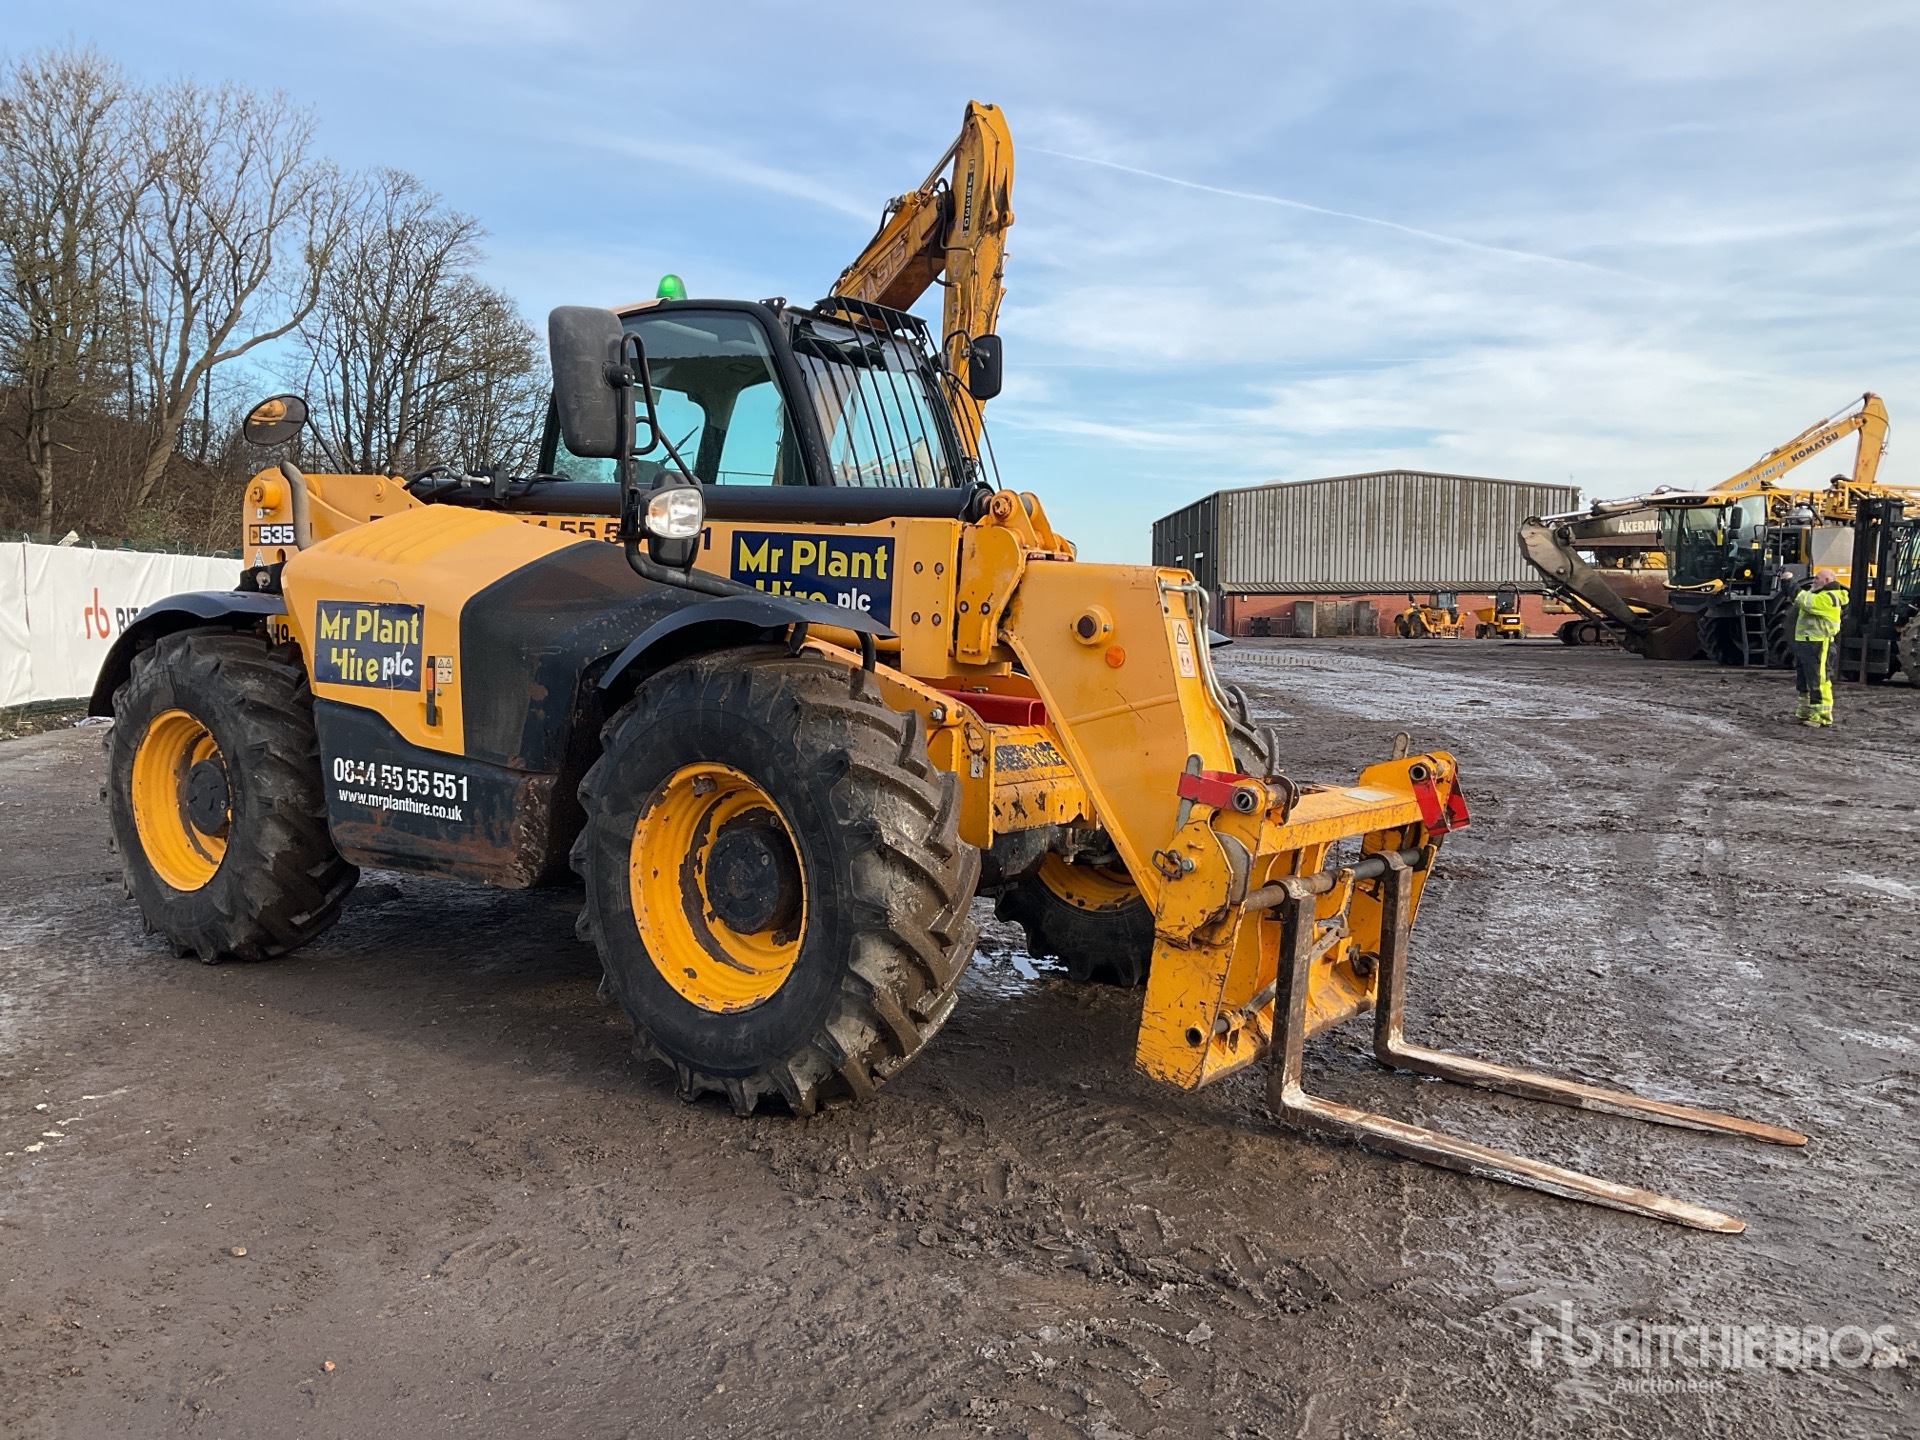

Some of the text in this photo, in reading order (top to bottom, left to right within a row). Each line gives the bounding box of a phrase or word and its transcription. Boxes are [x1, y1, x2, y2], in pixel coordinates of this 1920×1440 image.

[1790, 431, 1839, 462] KOMATSU
[738, 536, 888, 580] Mr Plant
[837, 587, 871, 612] plc
[320, 607, 419, 645] Mr Plant
[330, 647, 414, 683] Hire plc
[333, 757, 468, 802] 0844 55 55 551
[338, 789, 463, 821] www.mrplanthire.co.uk
